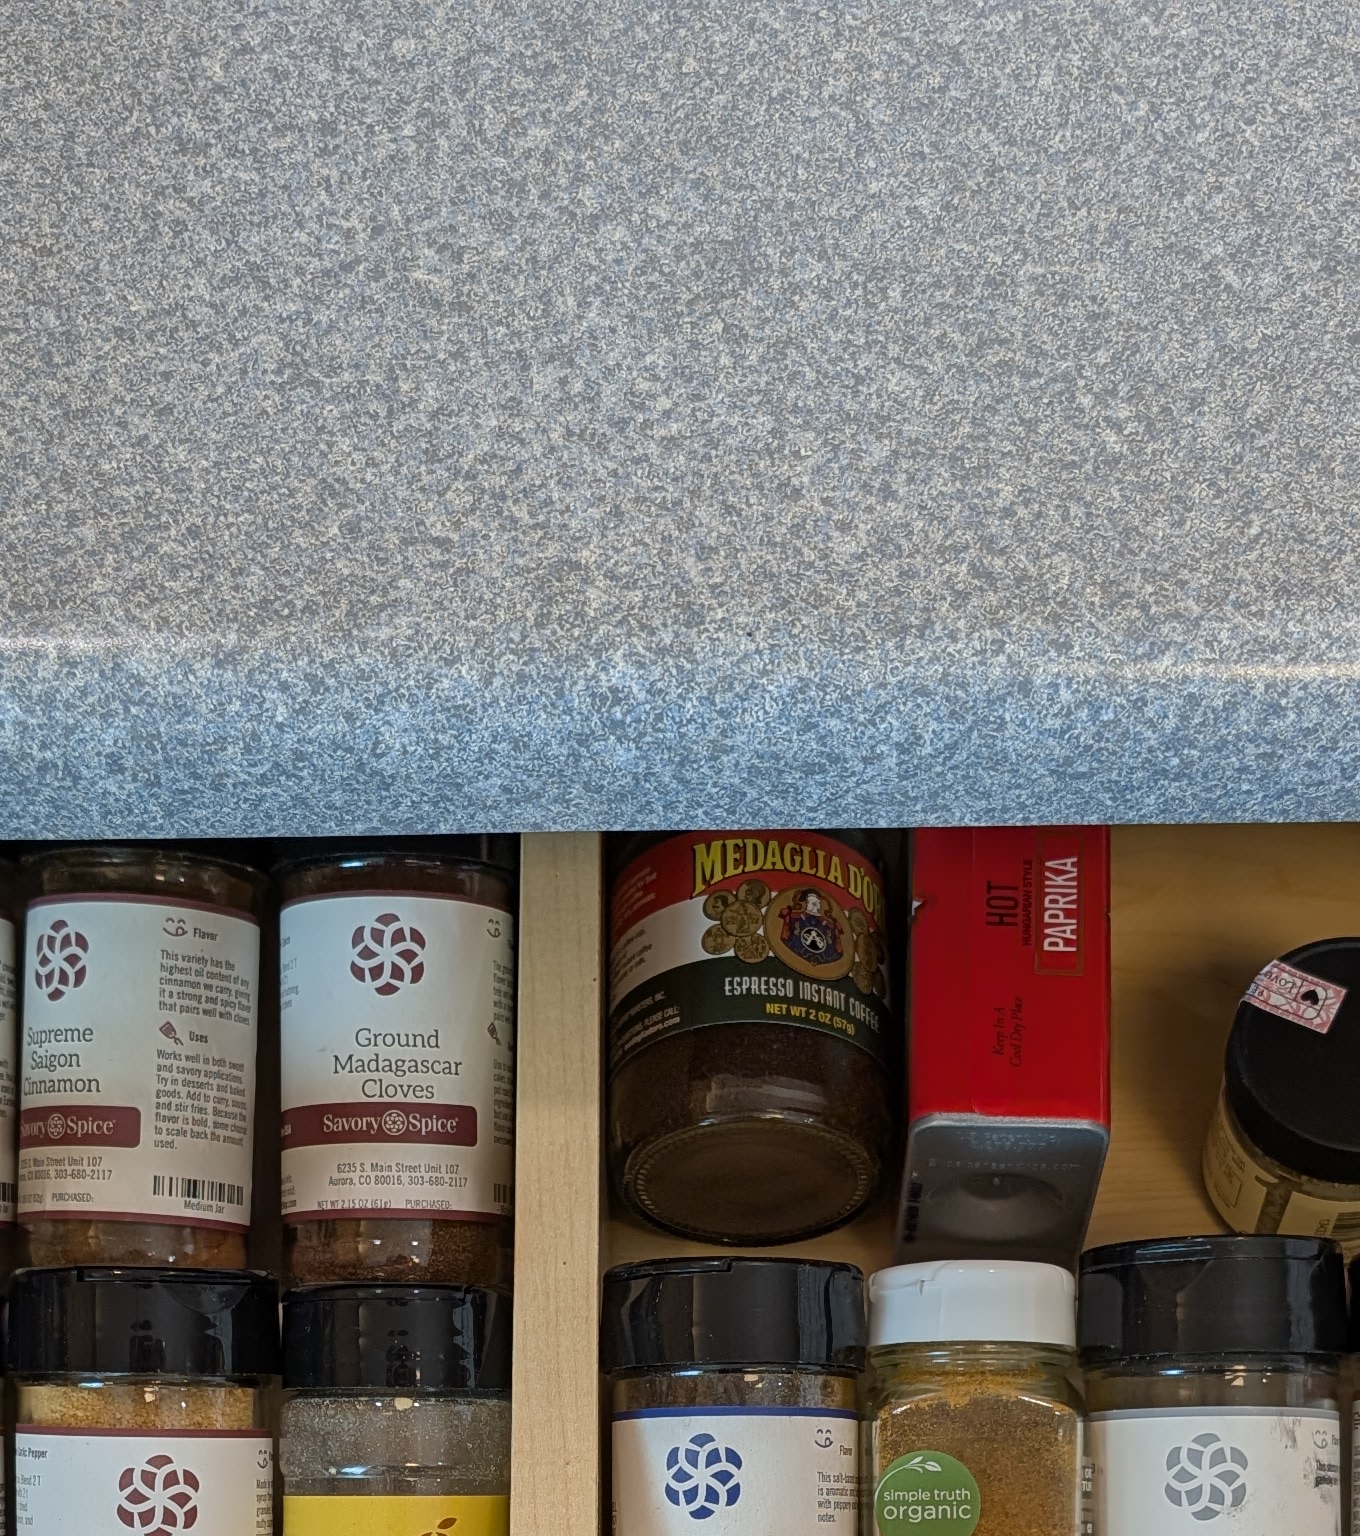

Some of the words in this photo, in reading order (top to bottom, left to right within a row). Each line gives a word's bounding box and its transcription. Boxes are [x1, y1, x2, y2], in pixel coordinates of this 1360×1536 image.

[690, 839, 842, 898] MEDAGLIA
[986, 880, 1019, 928] HOT
[1043, 856, 1078, 953] PAPRIKA
[723, 976, 794, 998] ESPRESSO
[798, 982, 846, 1009] INSTANT
[849, 996, 880, 1033] COFFEE
[27, 1027, 94, 1048] Supreme
[354, 1028, 441, 1049] Ground
[31, 1050, 81, 1072] Saigon
[332, 1054, 463, 1077] Madagascar
[361, 1079, 435, 1100] Cloves
[323, 1113, 381, 1136] Savory
[409, 1113, 459, 1135] Spice
[883, 1488, 930, 1504] simple
[934, 1488, 971, 1501] truth
[883, 1502, 972, 1523] organic
